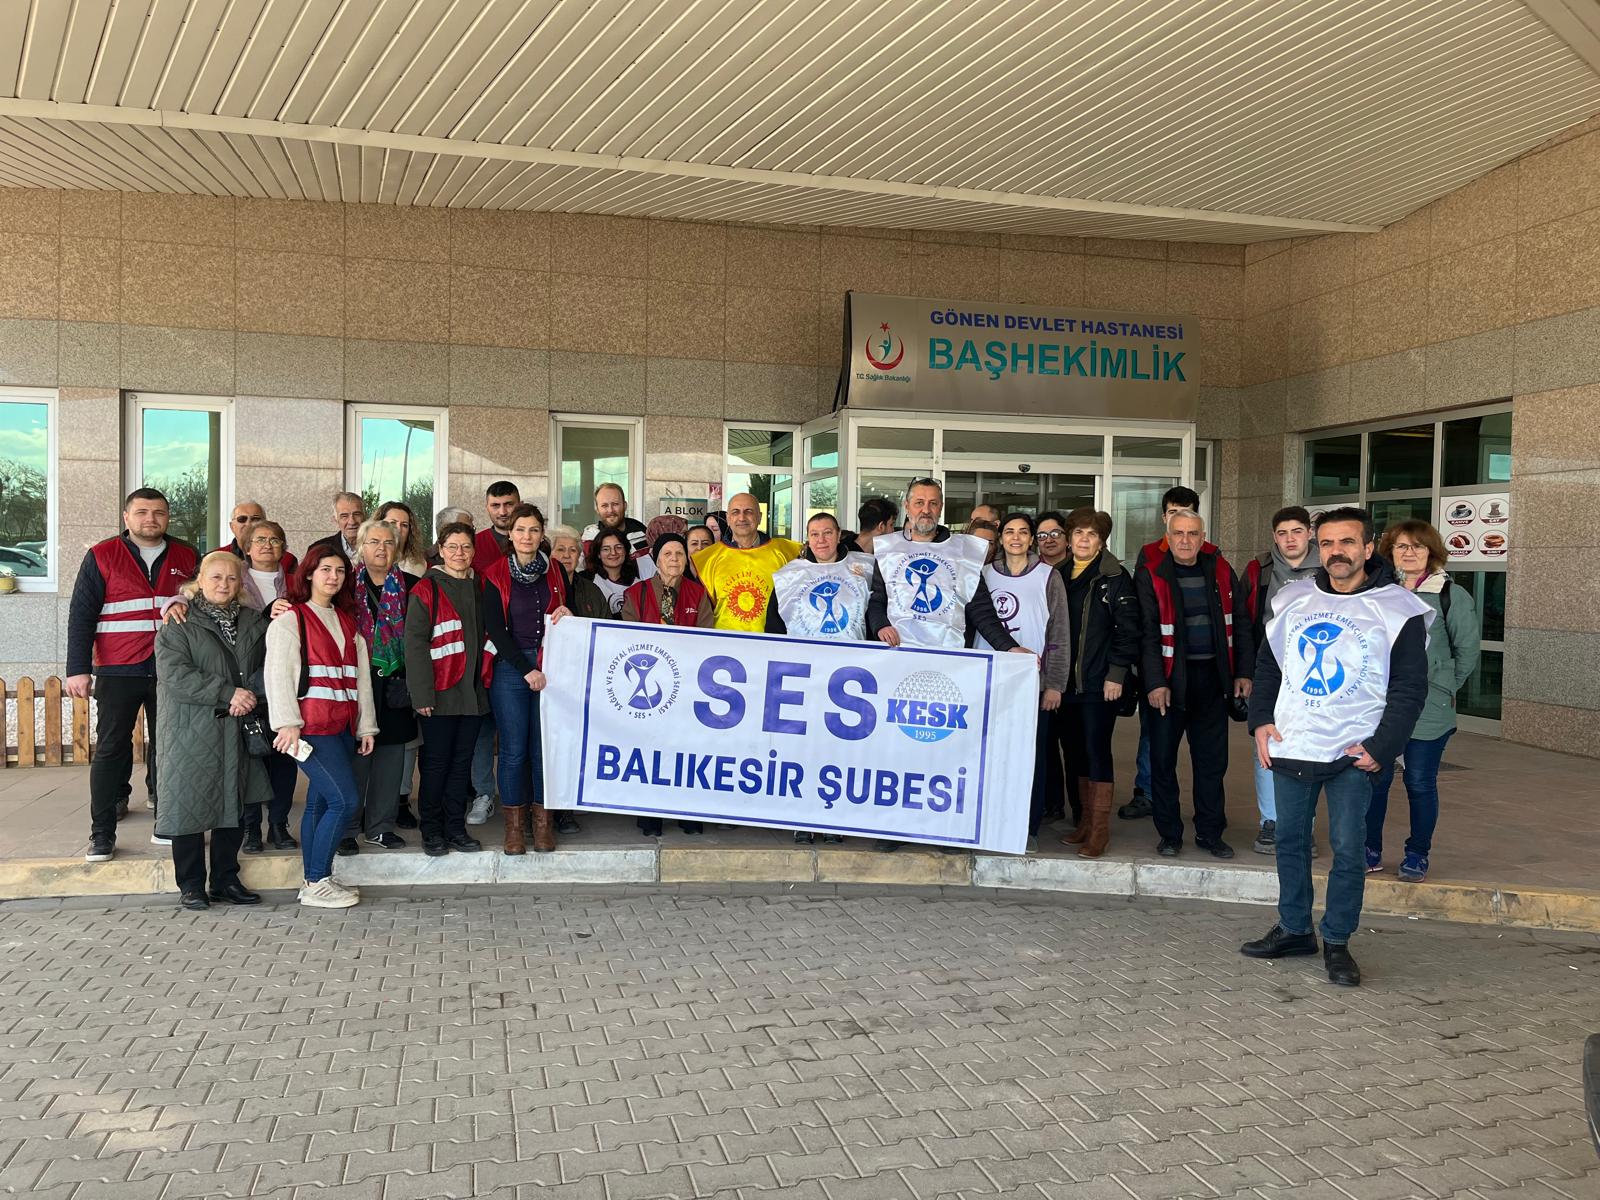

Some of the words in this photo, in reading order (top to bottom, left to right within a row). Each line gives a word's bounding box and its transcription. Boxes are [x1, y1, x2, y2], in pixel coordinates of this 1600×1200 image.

[930, 308, 1000, 328] GÖNEN
[1004, 314, 1077, 333] DEVLET
[1081, 320, 1184, 340] HASTANESİ
[928, 337, 1187, 382] BAŞHEKİMLİK
[664, 506, 673, 515] A
[675, 506, 704, 516] BLOK
[627, 643, 654, 654] HİZMET
[607, 649, 628, 675] SOSYAL
[654, 646, 682, 679] EMEKÇİLERİ
[606, 676, 613, 686] VE
[606, 687, 624, 711] SAĞLIK
[658, 680, 681, 715] SENDİKASI
[693, 655, 878, 742] SES
[1304, 698, 1321, 708] SES
[633, 711, 647, 719] SES
[886, 698, 969, 730] KESK
[915, 729, 937, 741] 1995
[596, 744, 804, 800] BALIKESİR
[817, 765, 967, 815] ŞUBESİ
